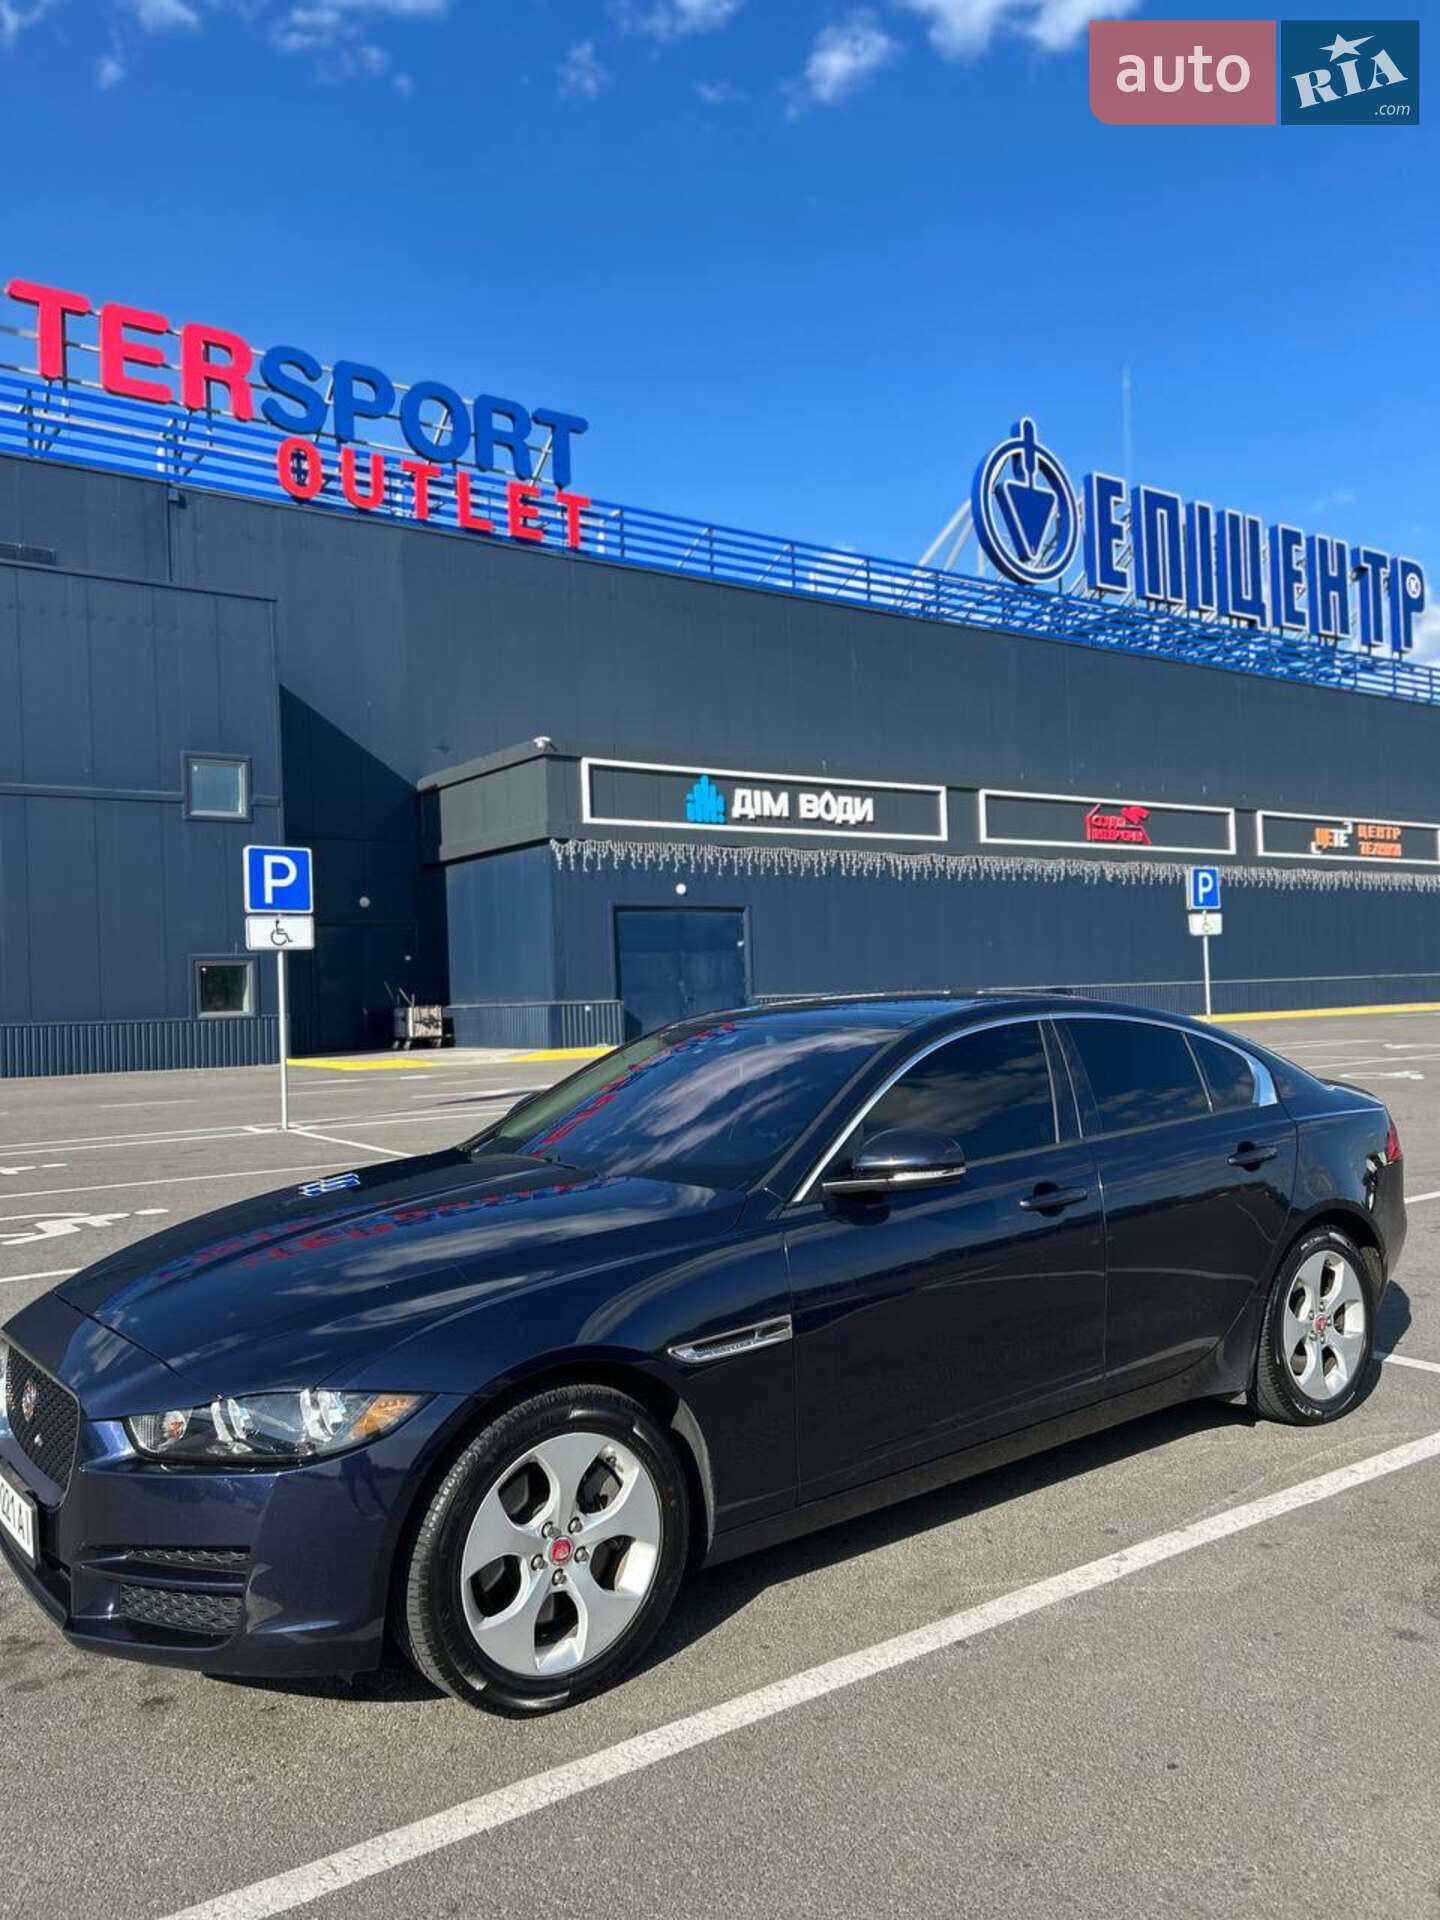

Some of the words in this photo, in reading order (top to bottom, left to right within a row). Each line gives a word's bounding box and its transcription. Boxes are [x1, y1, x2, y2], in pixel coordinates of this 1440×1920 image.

[5, 279, 588, 488] TERSPORT
[277, 437, 591, 549] OUTLET
[731, 788, 790, 819] ДІМ
[798, 790, 875, 825] ВОДИ
[264, 855, 297, 904] P
[1199, 872, 1213, 904] P
